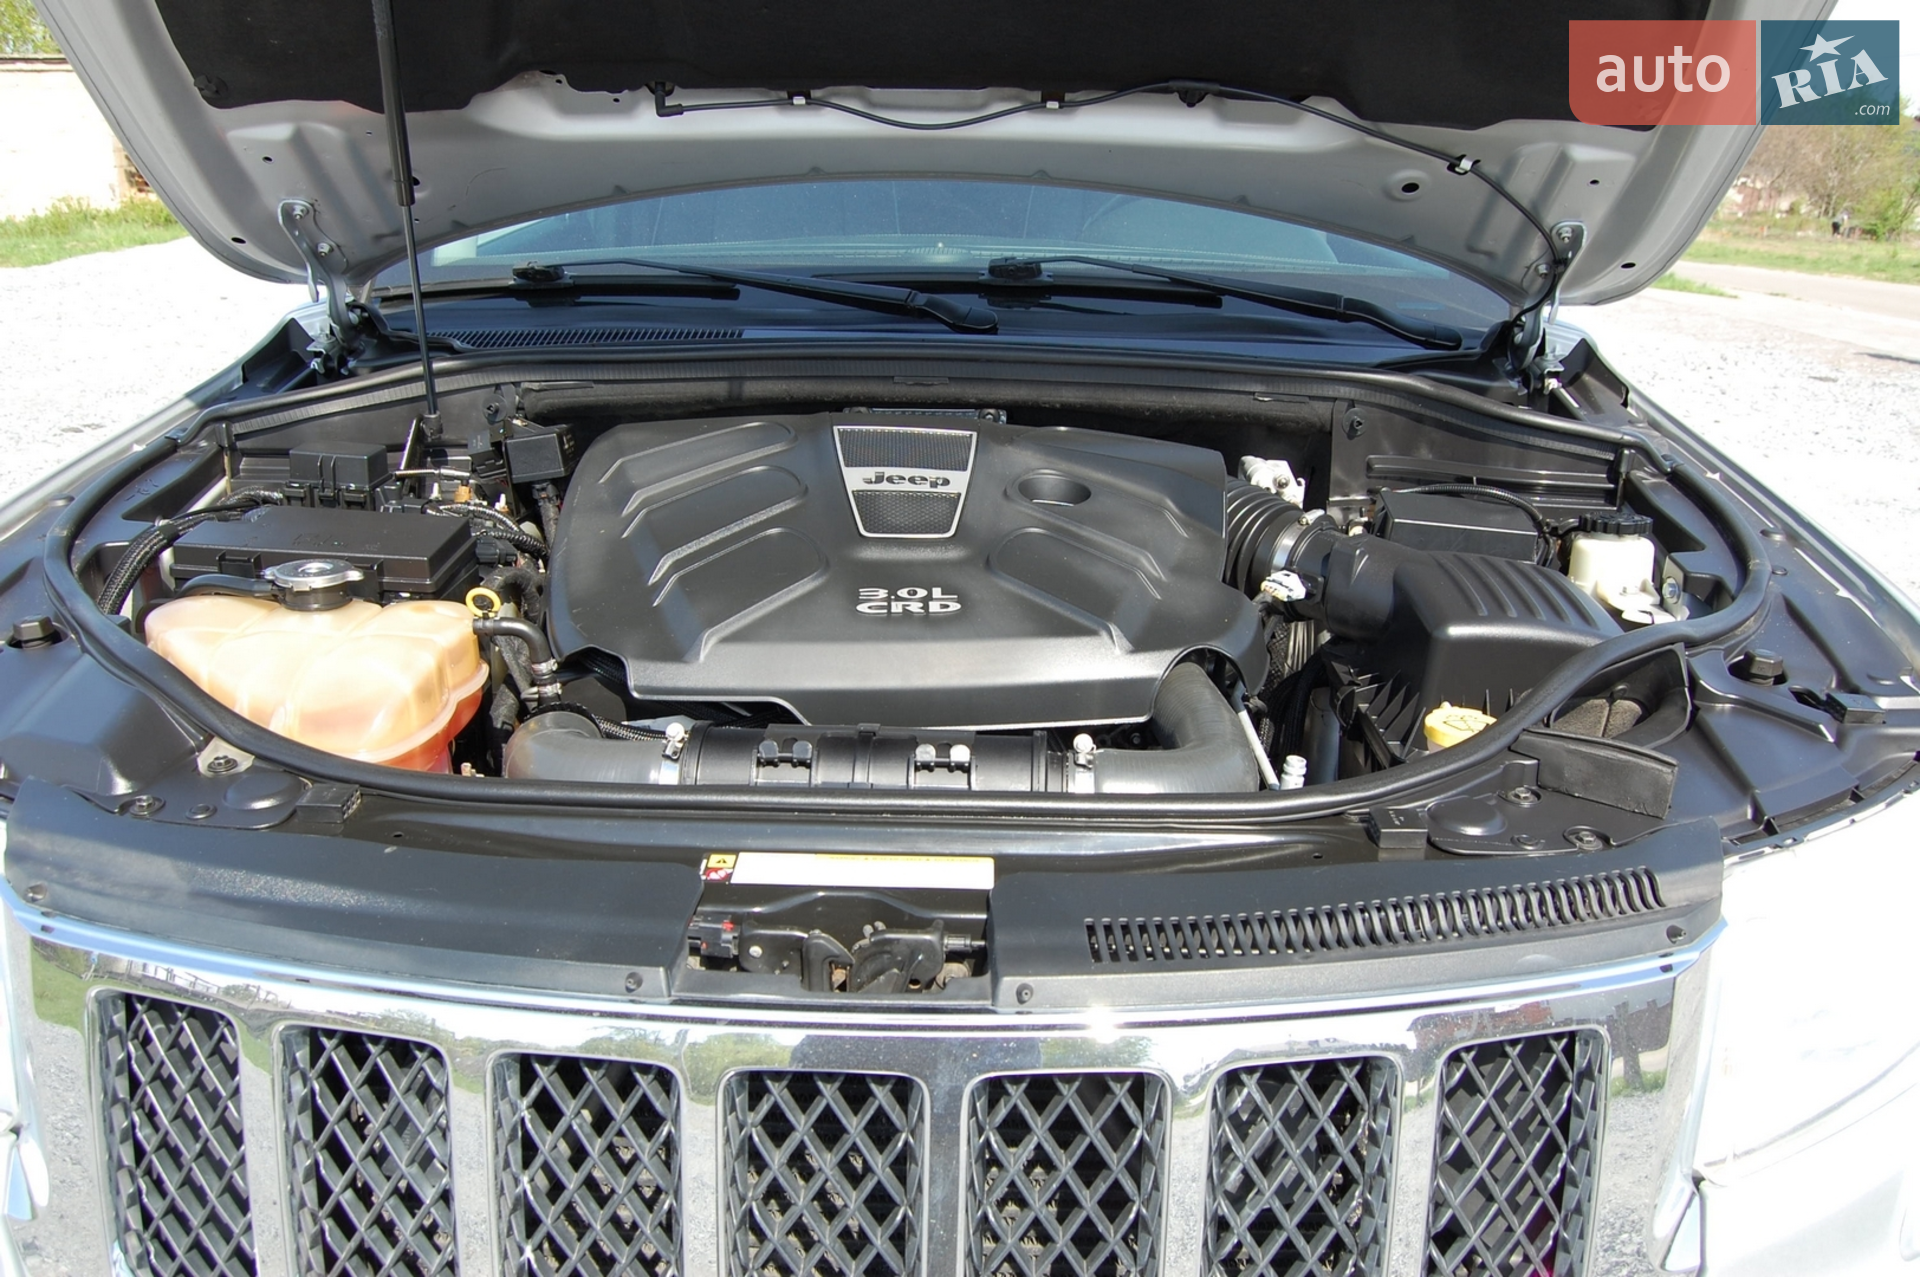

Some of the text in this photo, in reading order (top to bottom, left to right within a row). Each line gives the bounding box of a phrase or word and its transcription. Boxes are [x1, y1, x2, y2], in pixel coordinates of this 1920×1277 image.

[862, 471, 951, 489] Jeep
[858, 586, 959, 600] 3.0L
[856, 600, 962, 615] CRD
